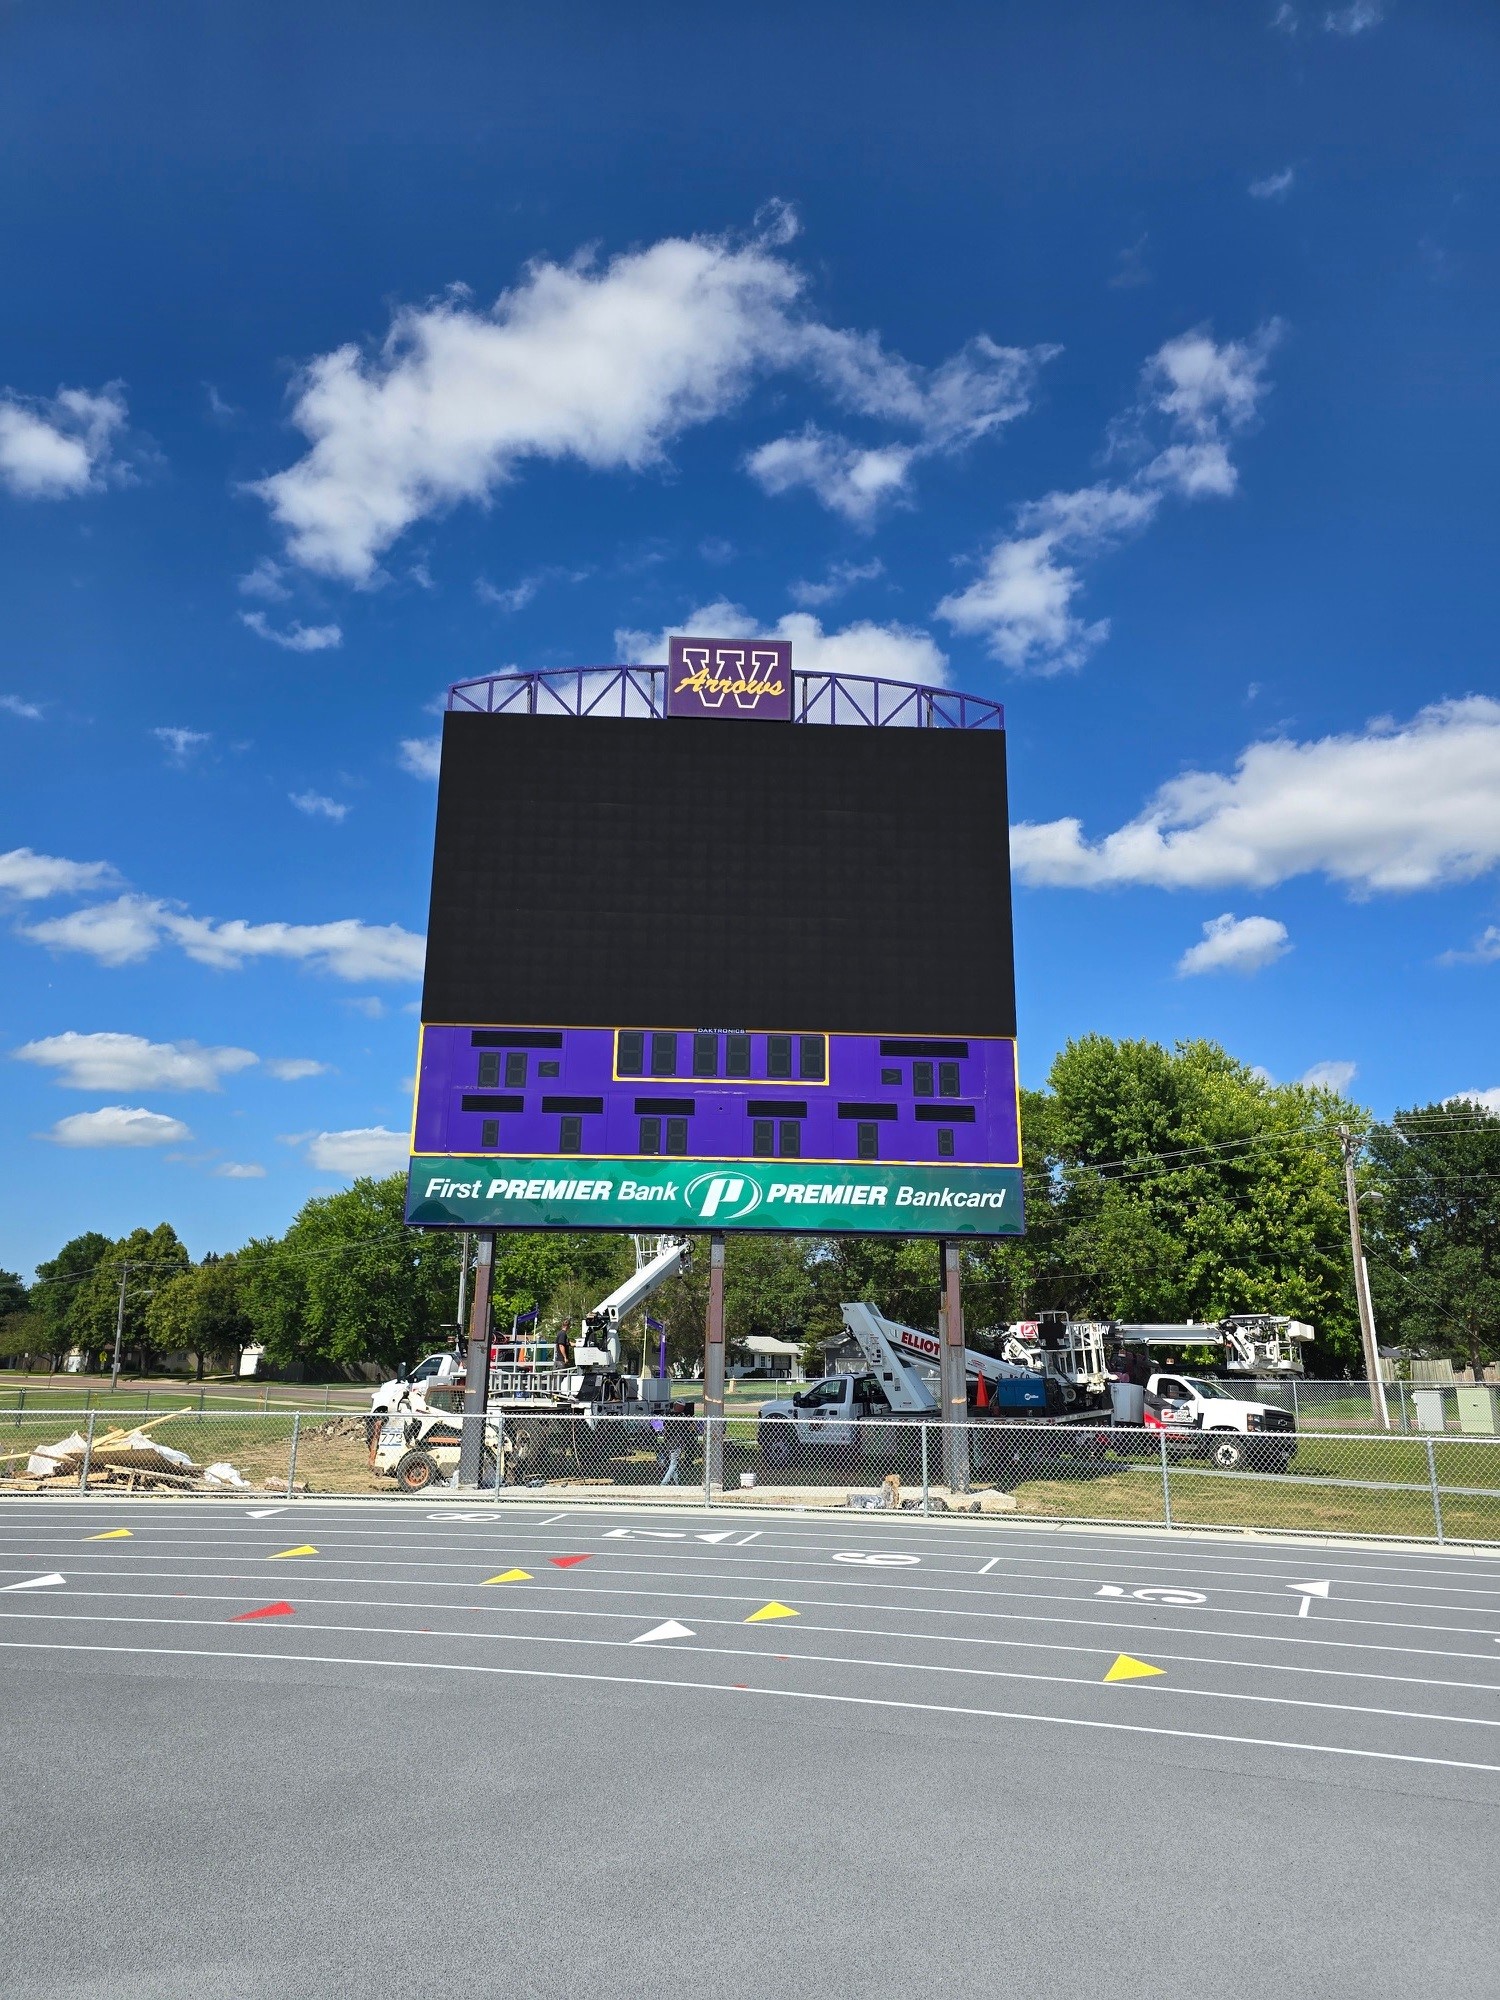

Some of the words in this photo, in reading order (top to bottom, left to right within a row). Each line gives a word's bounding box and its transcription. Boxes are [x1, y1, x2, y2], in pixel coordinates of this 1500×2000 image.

[674, 668, 785, 696] Arrows
[424, 1178, 482, 1199] First
[486, 1179, 613, 1201] PREMIER
[617, 1180, 679, 1201] Bank
[766, 1183, 889, 1206] PREMIER
[895, 1186, 1007, 1208] Bankcard
[381, 1433, 403, 1443] 773
[426, 1512, 502, 1522] 8
[832, 1552, 922, 1566] 6
[1094, 1584, 1207, 1604] 5
